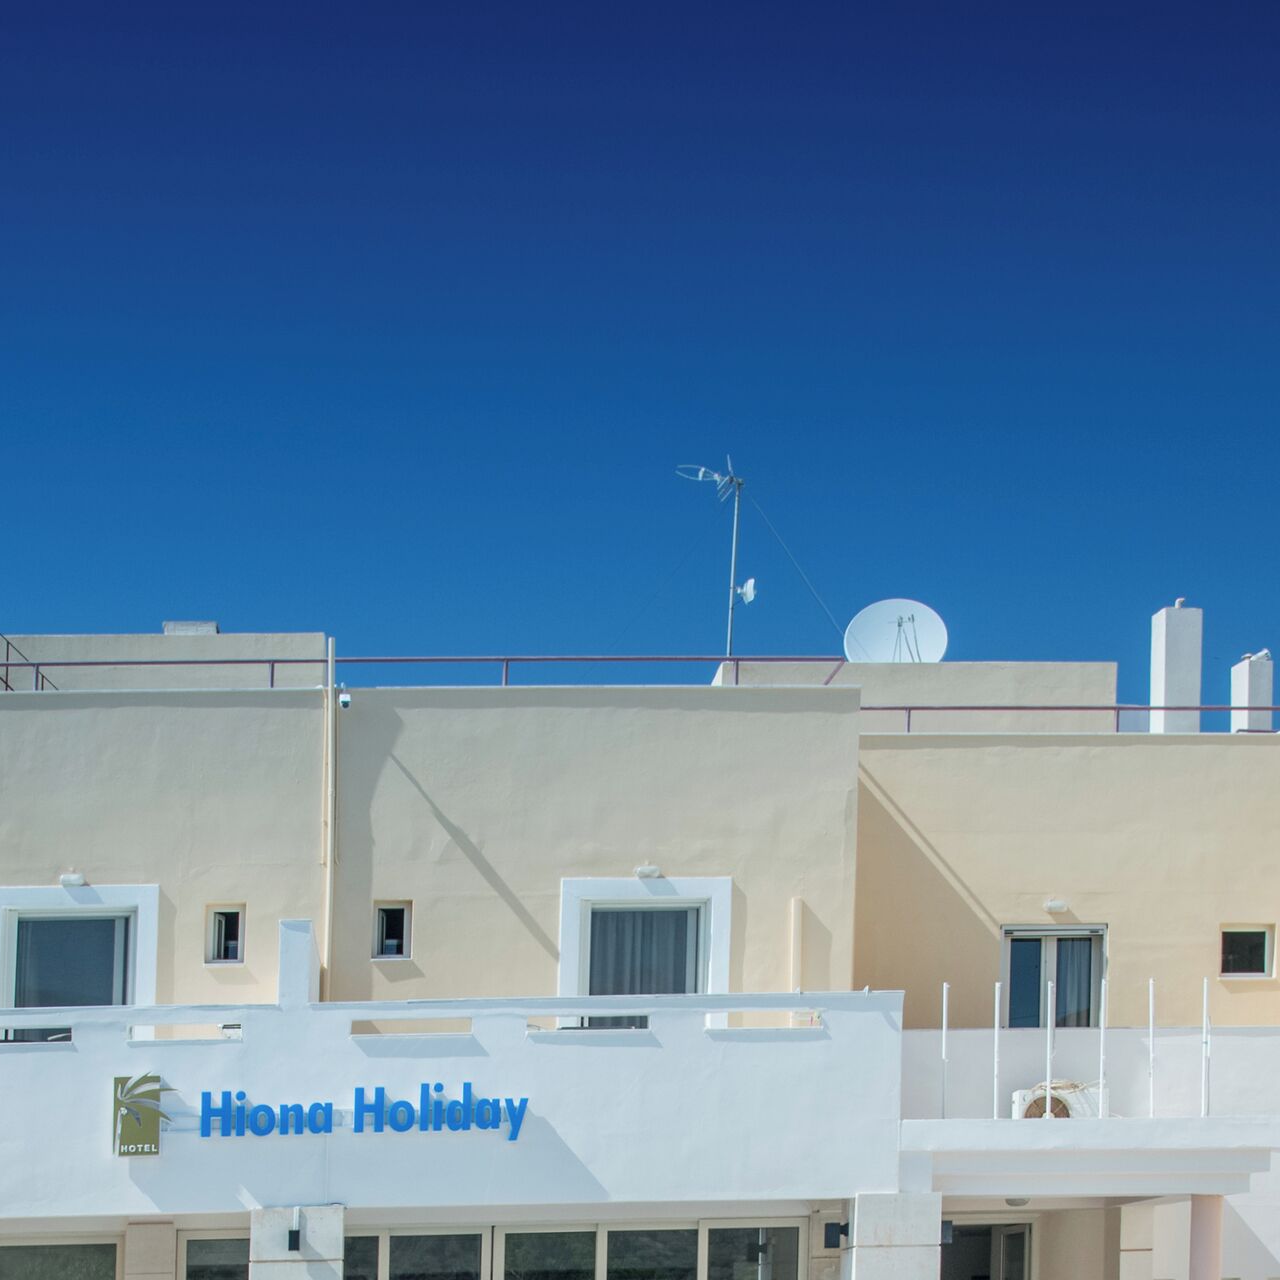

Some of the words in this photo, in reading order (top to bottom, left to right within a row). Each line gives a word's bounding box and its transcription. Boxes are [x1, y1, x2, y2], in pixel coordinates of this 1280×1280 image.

[200, 1090, 333, 1137] Hiona
[353, 1082, 529, 1141] Holiday
[120, 1144, 158, 1153] HOTEL
